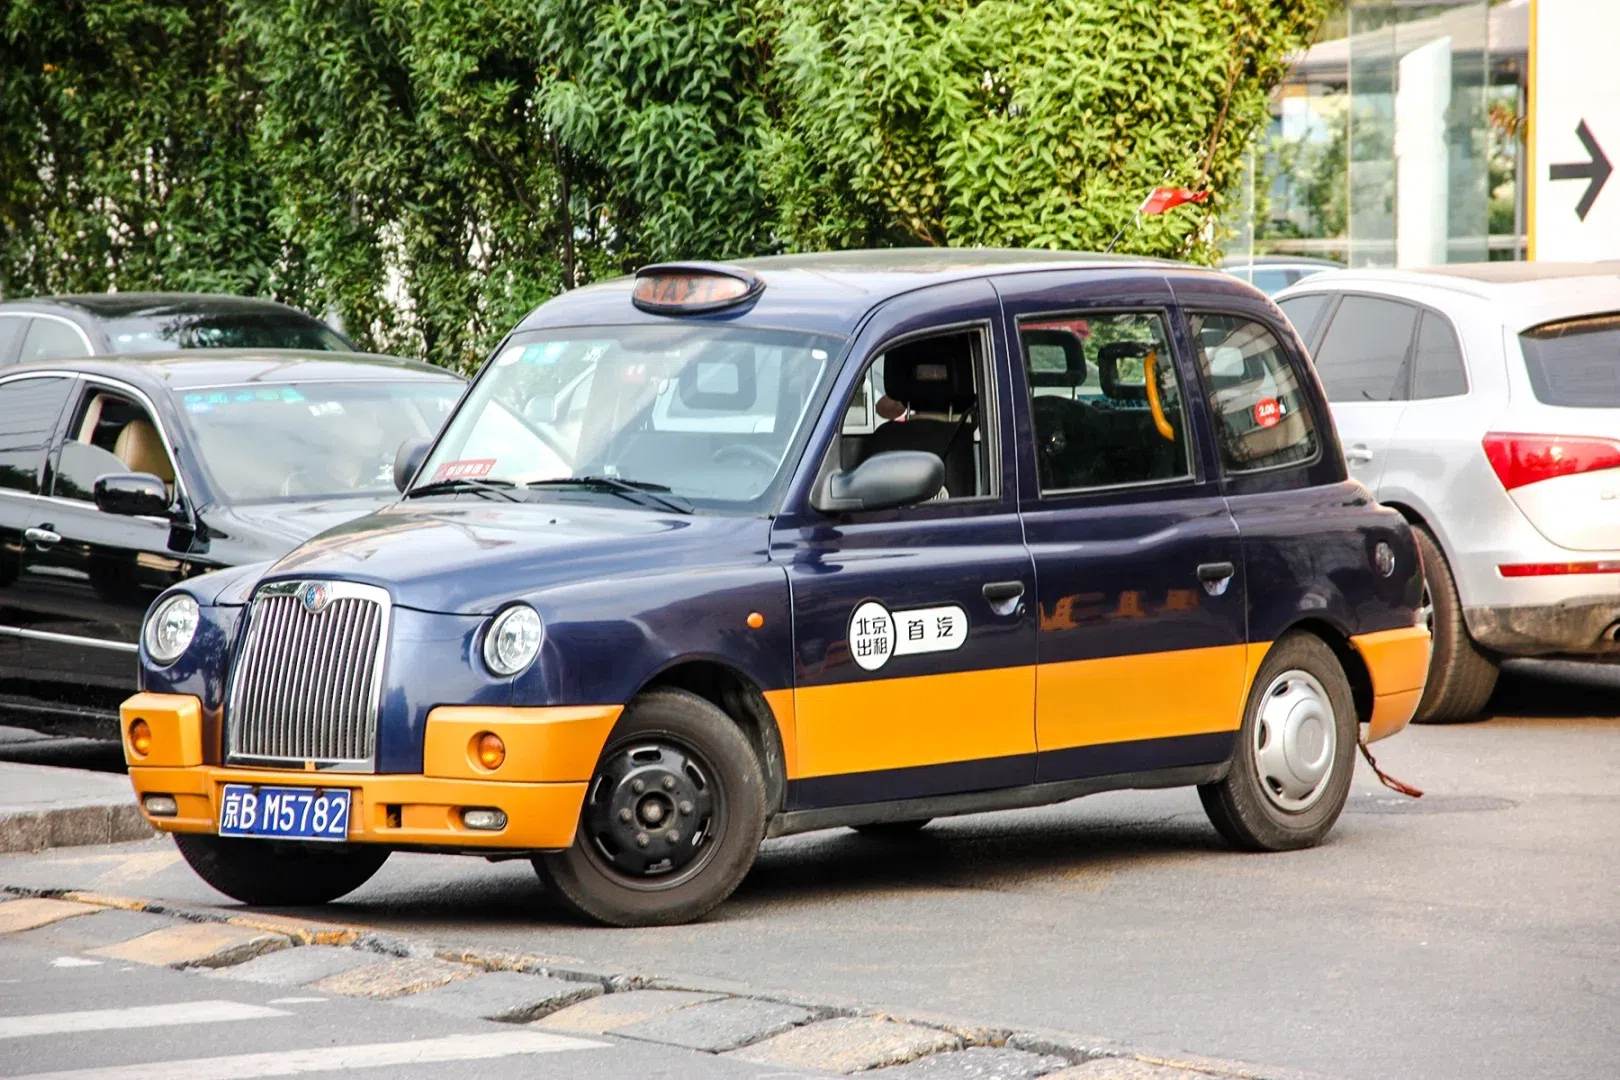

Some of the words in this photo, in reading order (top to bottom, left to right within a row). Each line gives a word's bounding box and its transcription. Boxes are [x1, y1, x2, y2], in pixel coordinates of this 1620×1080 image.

[649, 274, 717, 302] TAXI
[856, 616, 888, 636] 北京
[907, 616, 954, 641] 首汽
[857, 636, 888, 657] 出租
[223, 793, 258, 829] 京B
[262, 794, 347, 833] M5782
